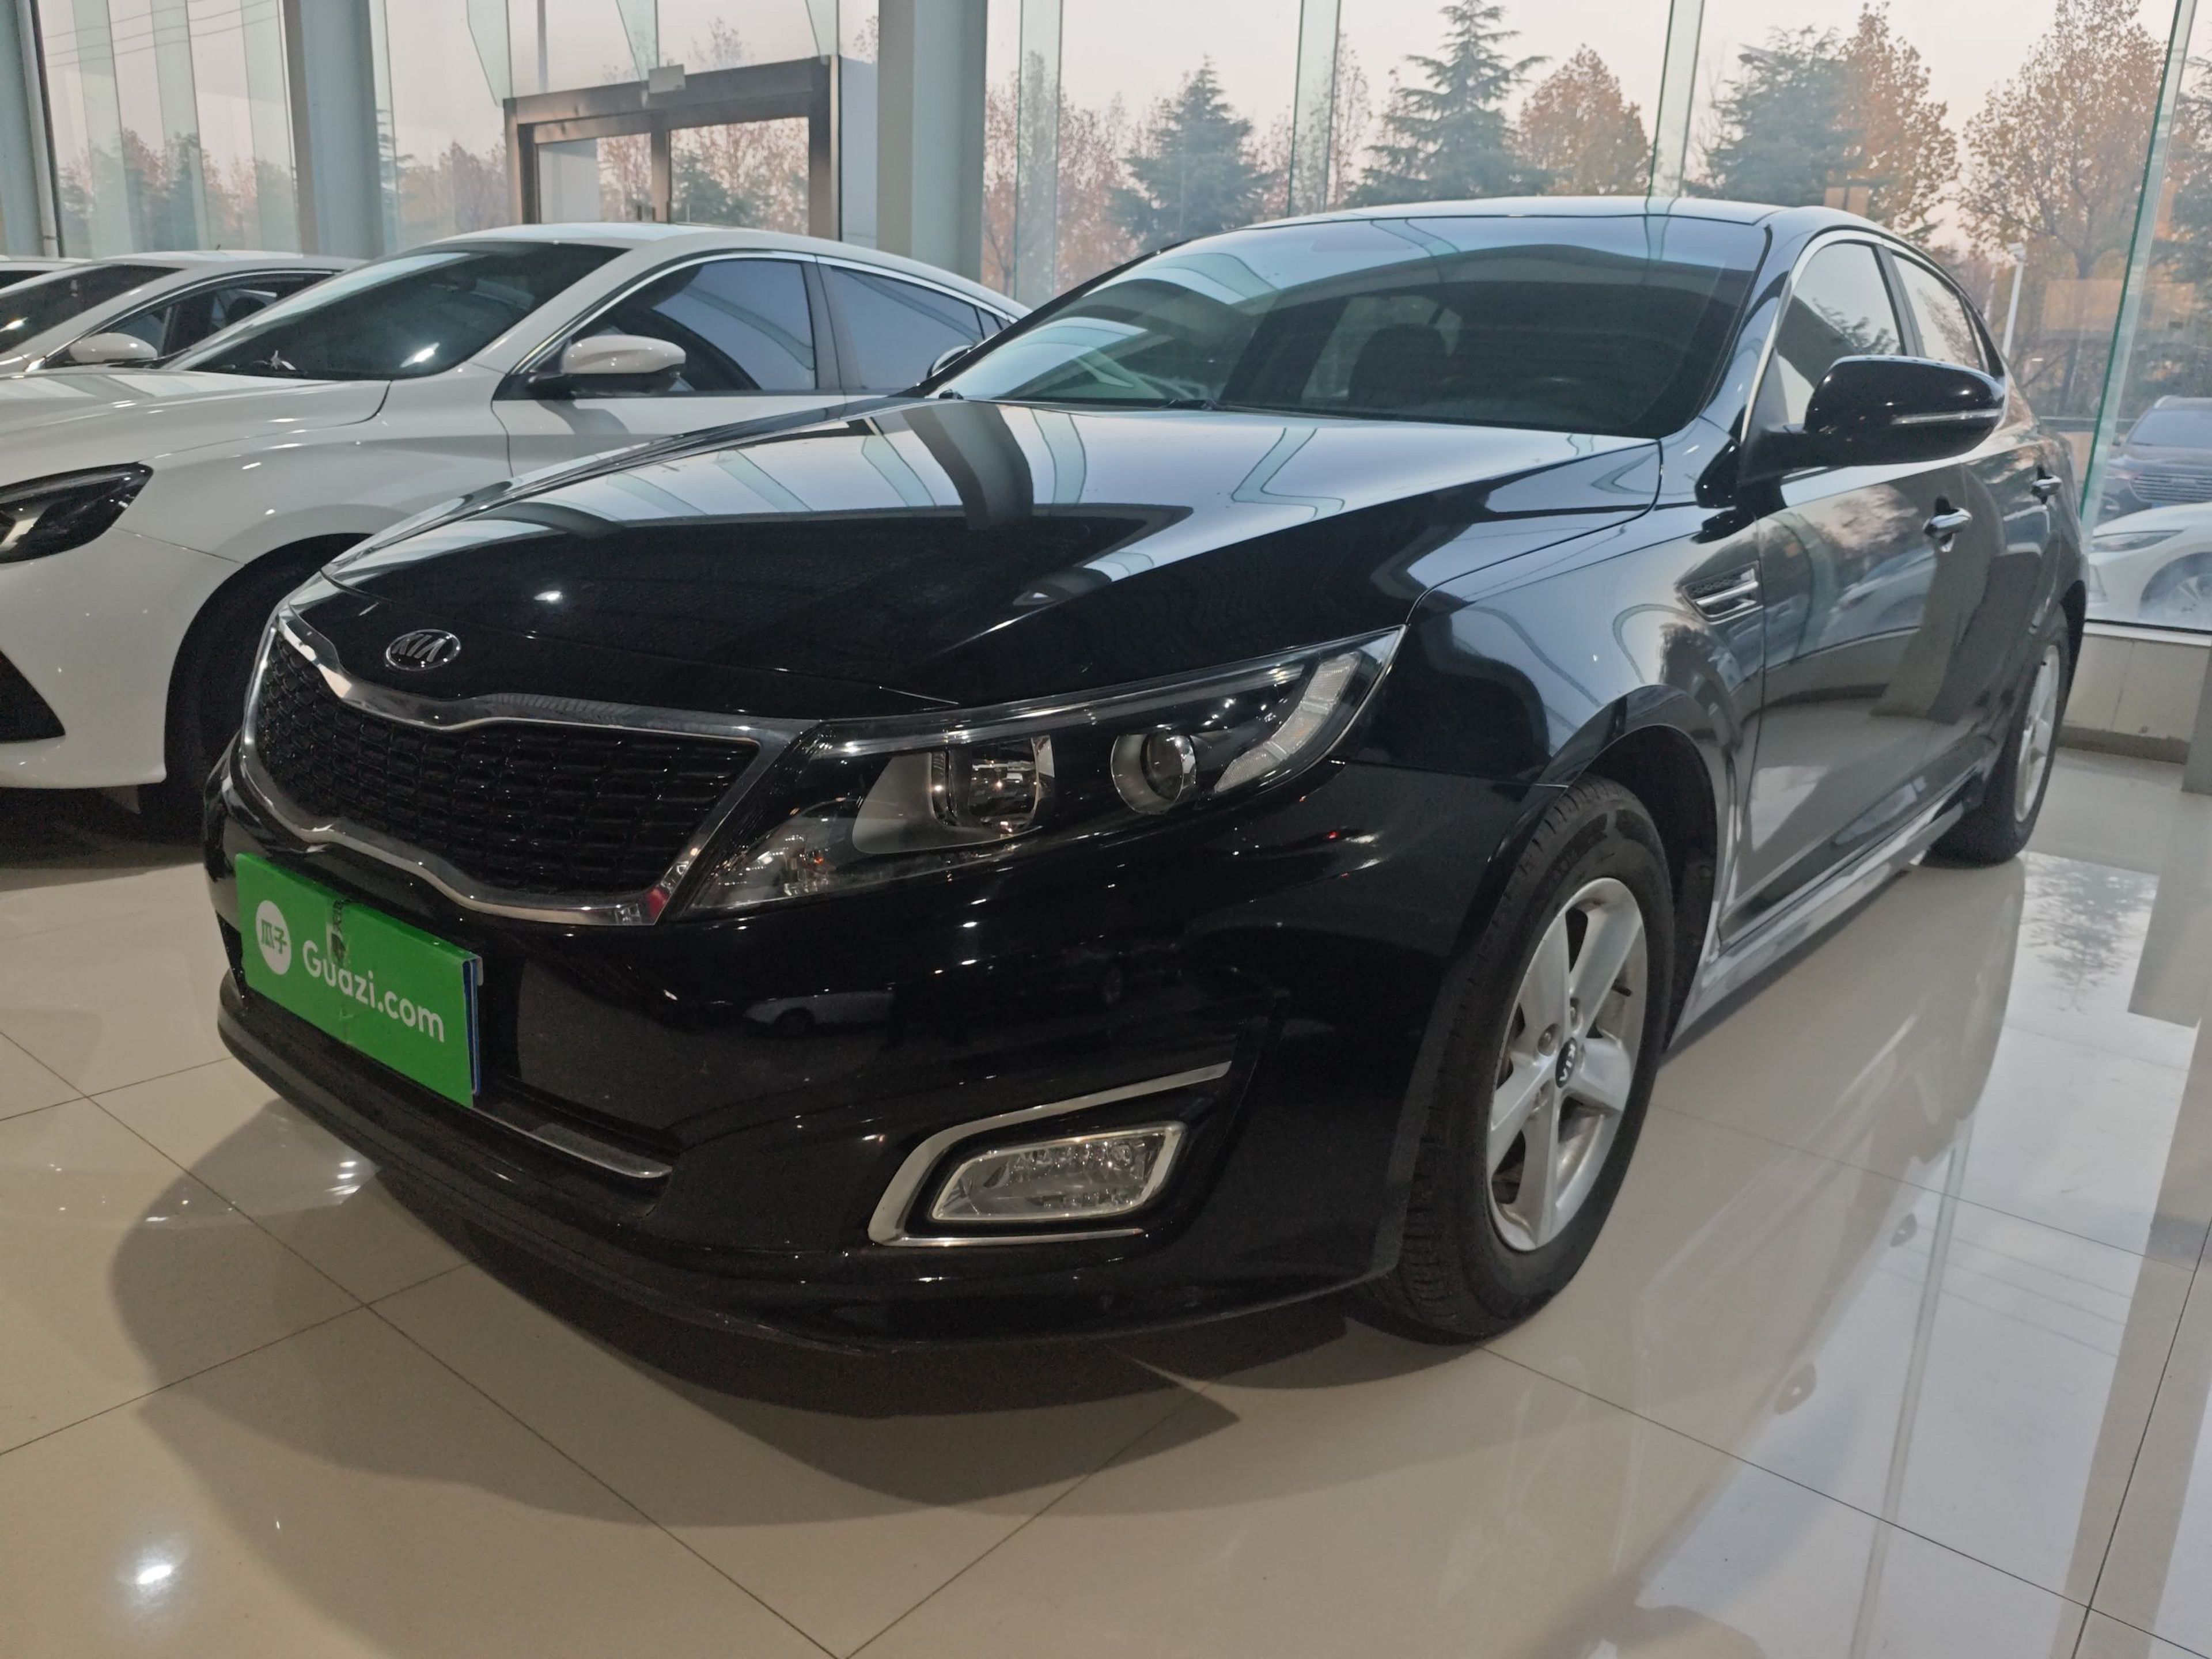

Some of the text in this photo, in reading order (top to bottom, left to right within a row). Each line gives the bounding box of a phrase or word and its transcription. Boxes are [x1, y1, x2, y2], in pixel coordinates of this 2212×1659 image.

[391, 634, 446, 662] KIA
[260, 919, 287, 954] 瓜子
[302, 940, 444, 1043] Guazi.com
[1559, 1043, 1576, 1081] KIA
